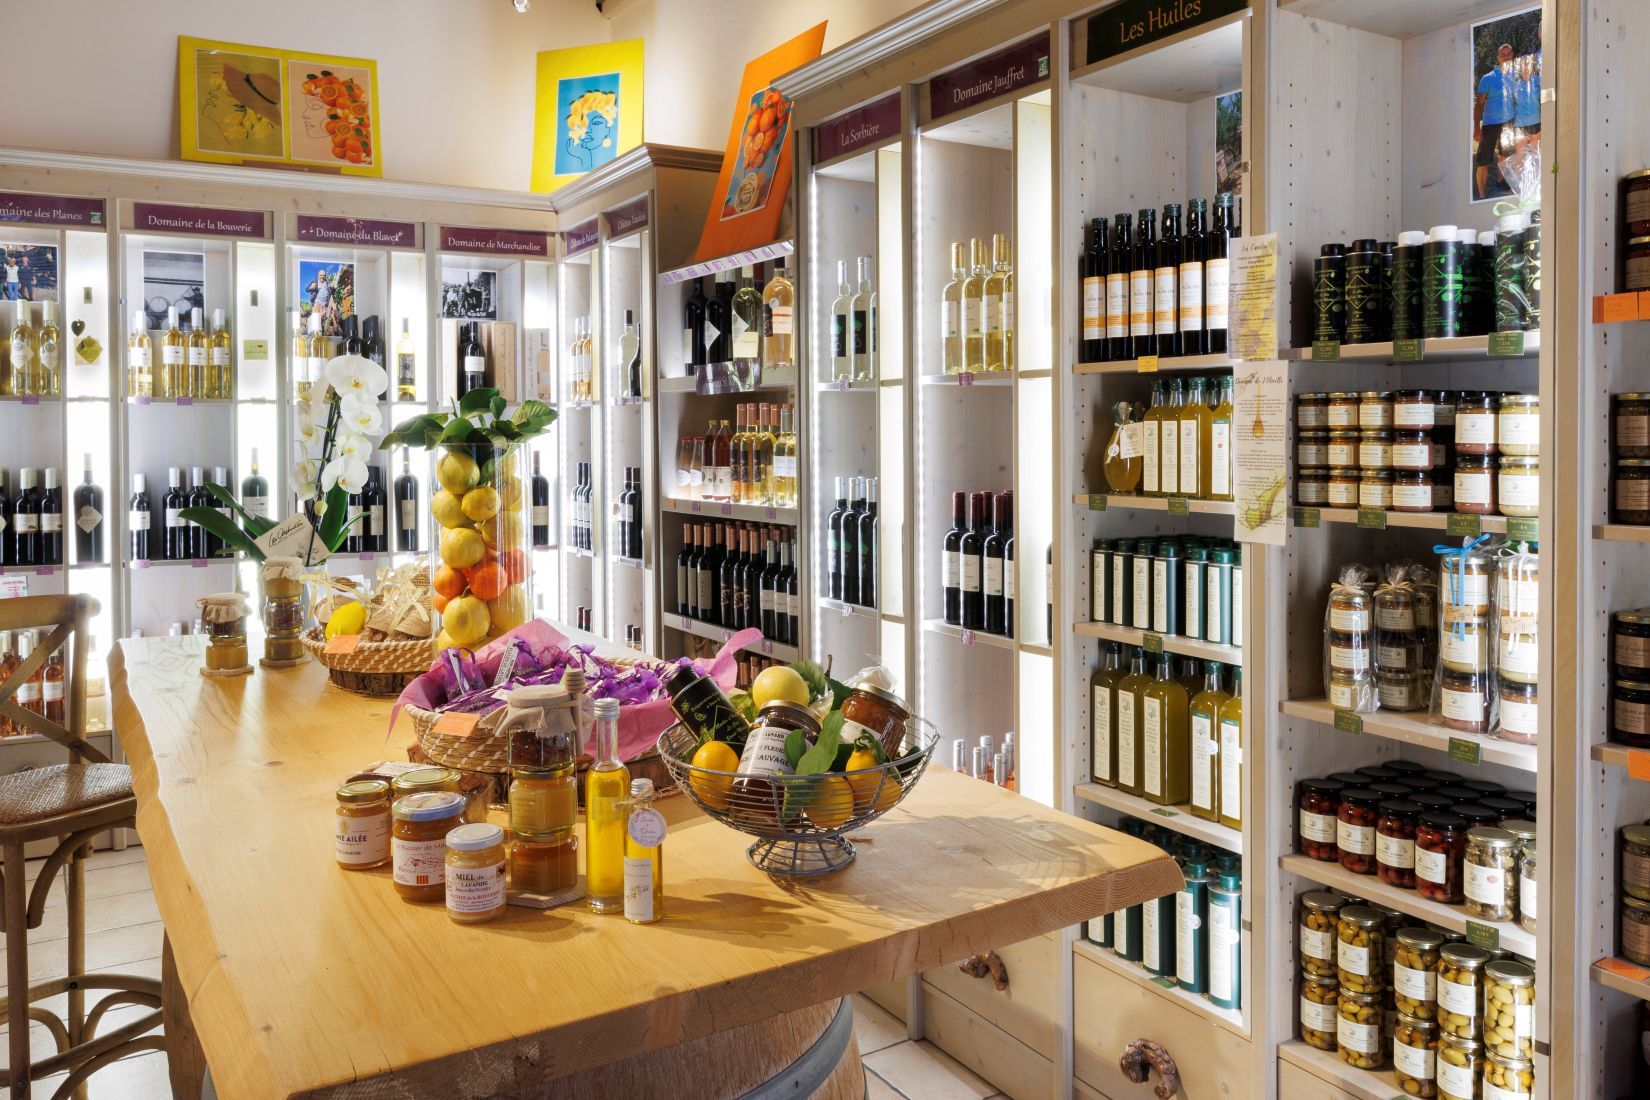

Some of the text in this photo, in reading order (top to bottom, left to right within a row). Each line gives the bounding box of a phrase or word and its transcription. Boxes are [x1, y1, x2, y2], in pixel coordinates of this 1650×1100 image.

[1120, 0, 1201, 43] Les Huiles
[953, 65, 1025, 103] Domaine Jauffret
[841, 122, 880, 146] La Sorbière
[34, 207, 50, 218] des
[52, 209, 82, 220] Planes
[148, 215, 253, 232] Domaine de la Bouverie
[316, 227, 400, 242] Domaine du Blavet
[447, 237, 541, 251] Domaine de Marchandise
[346, 834, 368, 843] AILÉE
[456, 873, 475, 881] MIEL
